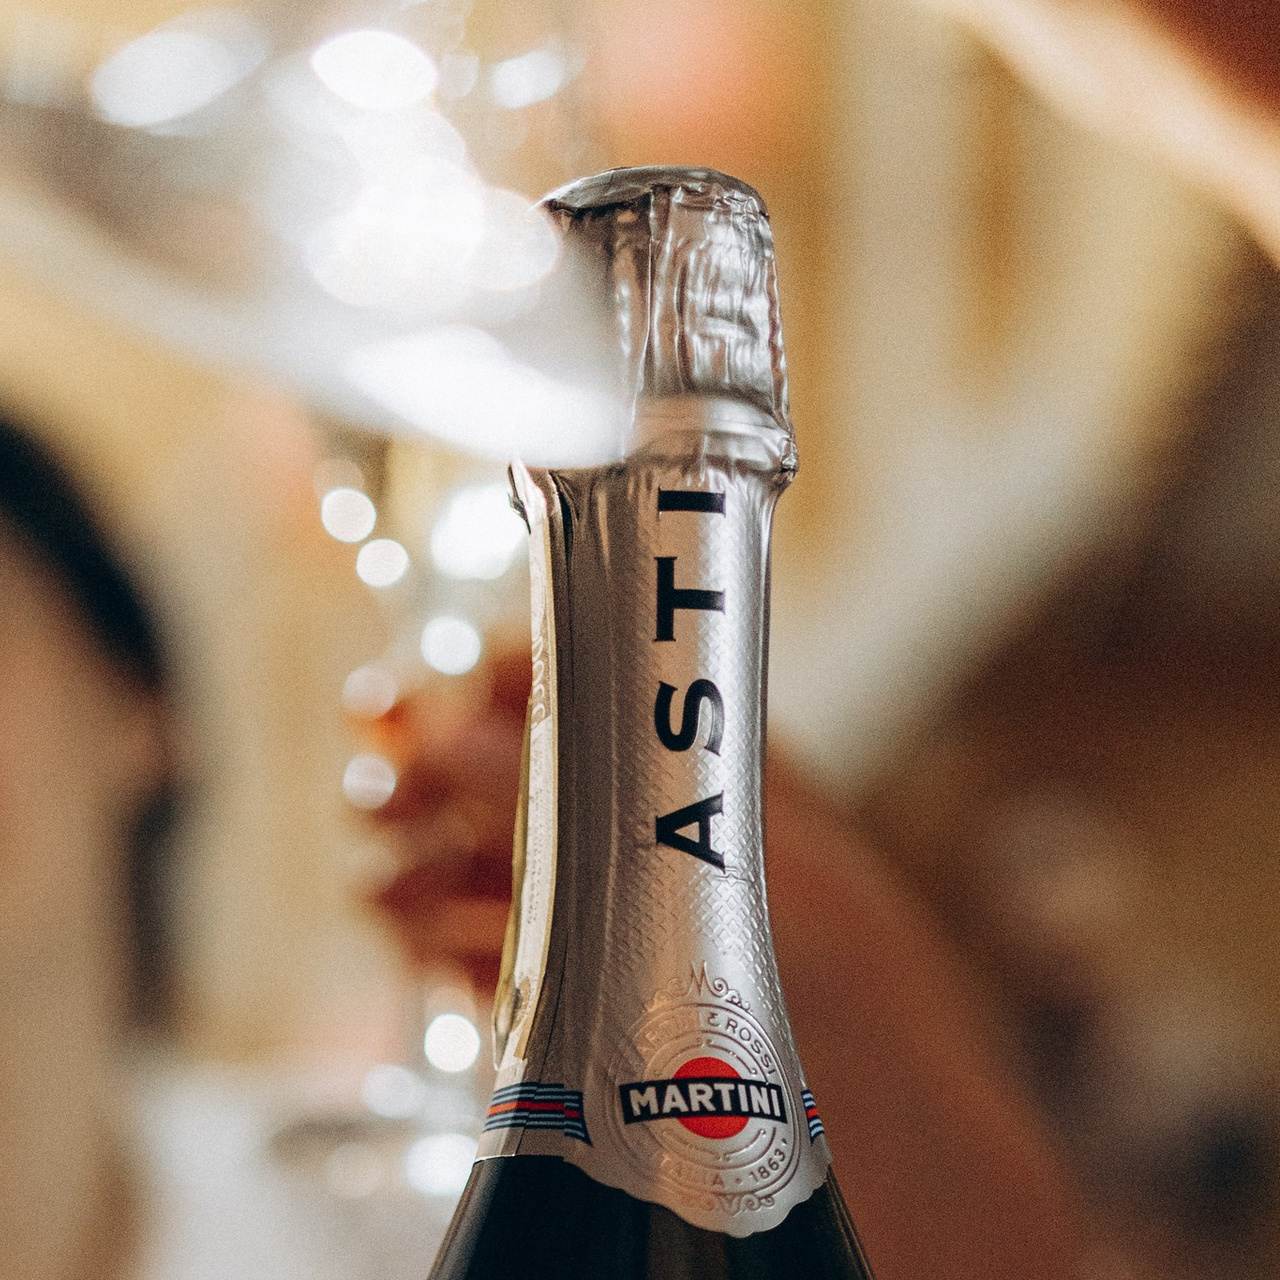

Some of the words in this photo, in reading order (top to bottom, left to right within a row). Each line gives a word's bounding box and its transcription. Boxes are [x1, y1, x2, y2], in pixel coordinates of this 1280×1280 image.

[653, 486, 727, 873] ASTI
[725, 1017, 776, 1076] ROSSI
[631, 1083, 781, 1117] MARTINI
[749, 1148, 786, 1183] 1863
